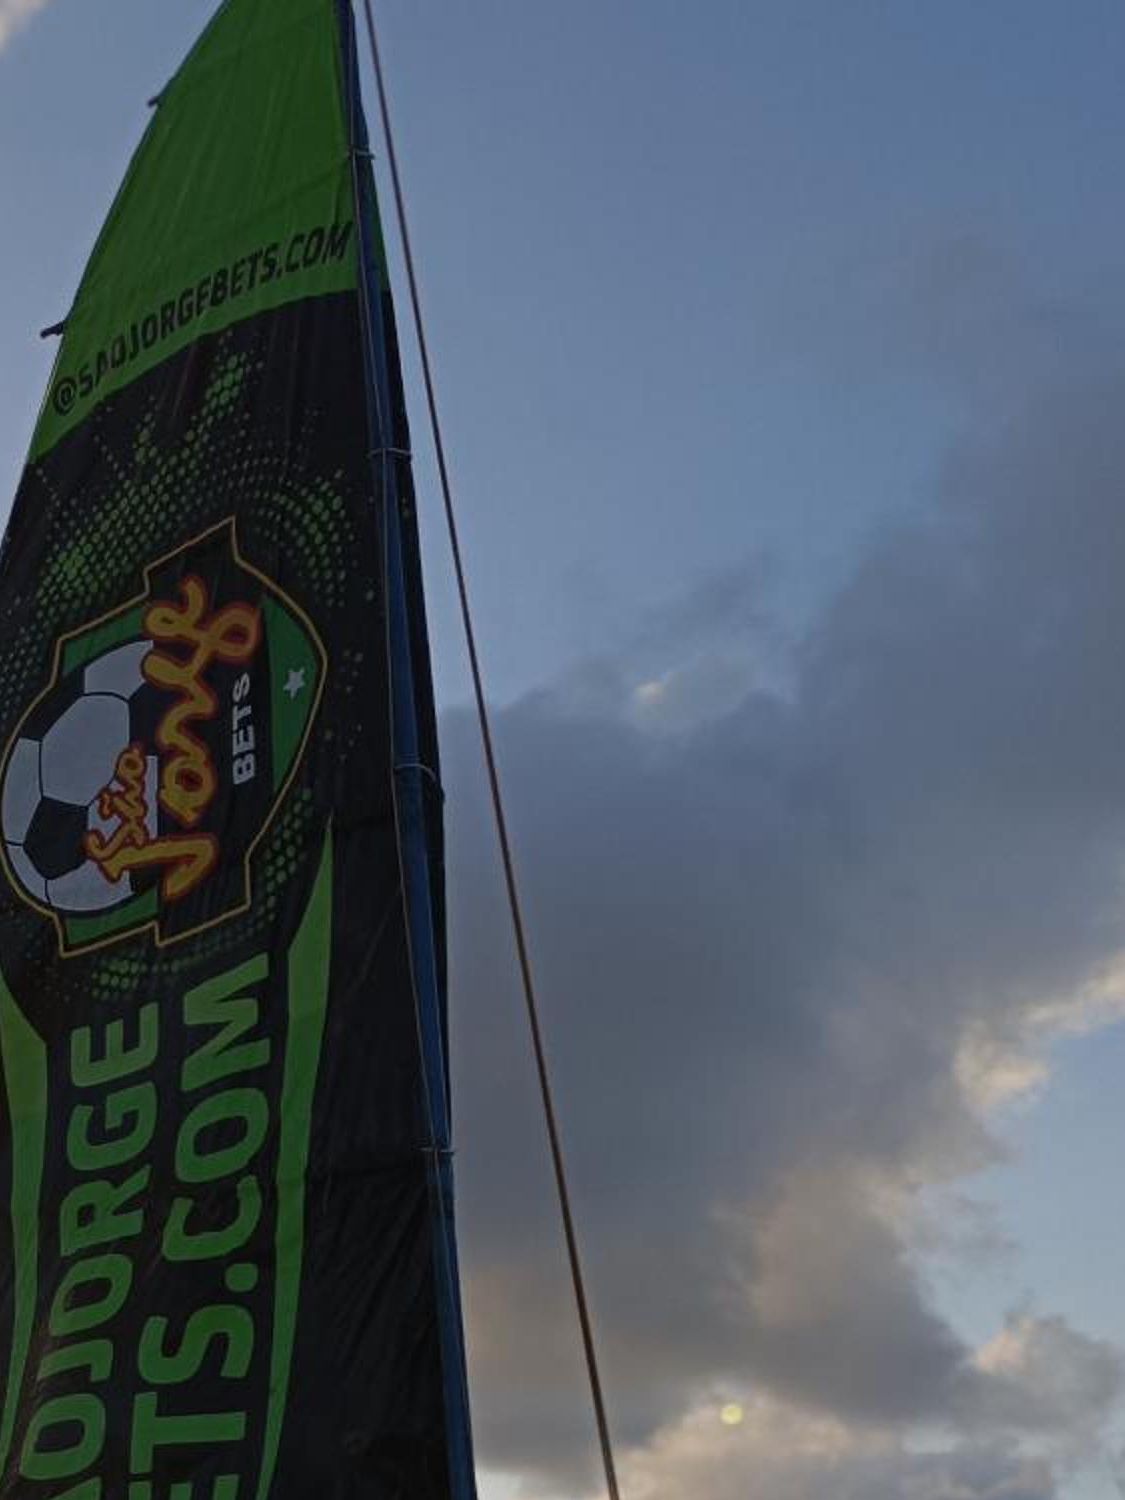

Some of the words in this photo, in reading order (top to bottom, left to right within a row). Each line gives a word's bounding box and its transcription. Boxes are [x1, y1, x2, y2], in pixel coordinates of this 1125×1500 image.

[50, 222, 353, 415] @SAOJORGEBETS.COM
[99, 574, 260, 898] Jorge
[230, 671, 258, 786] BETS
